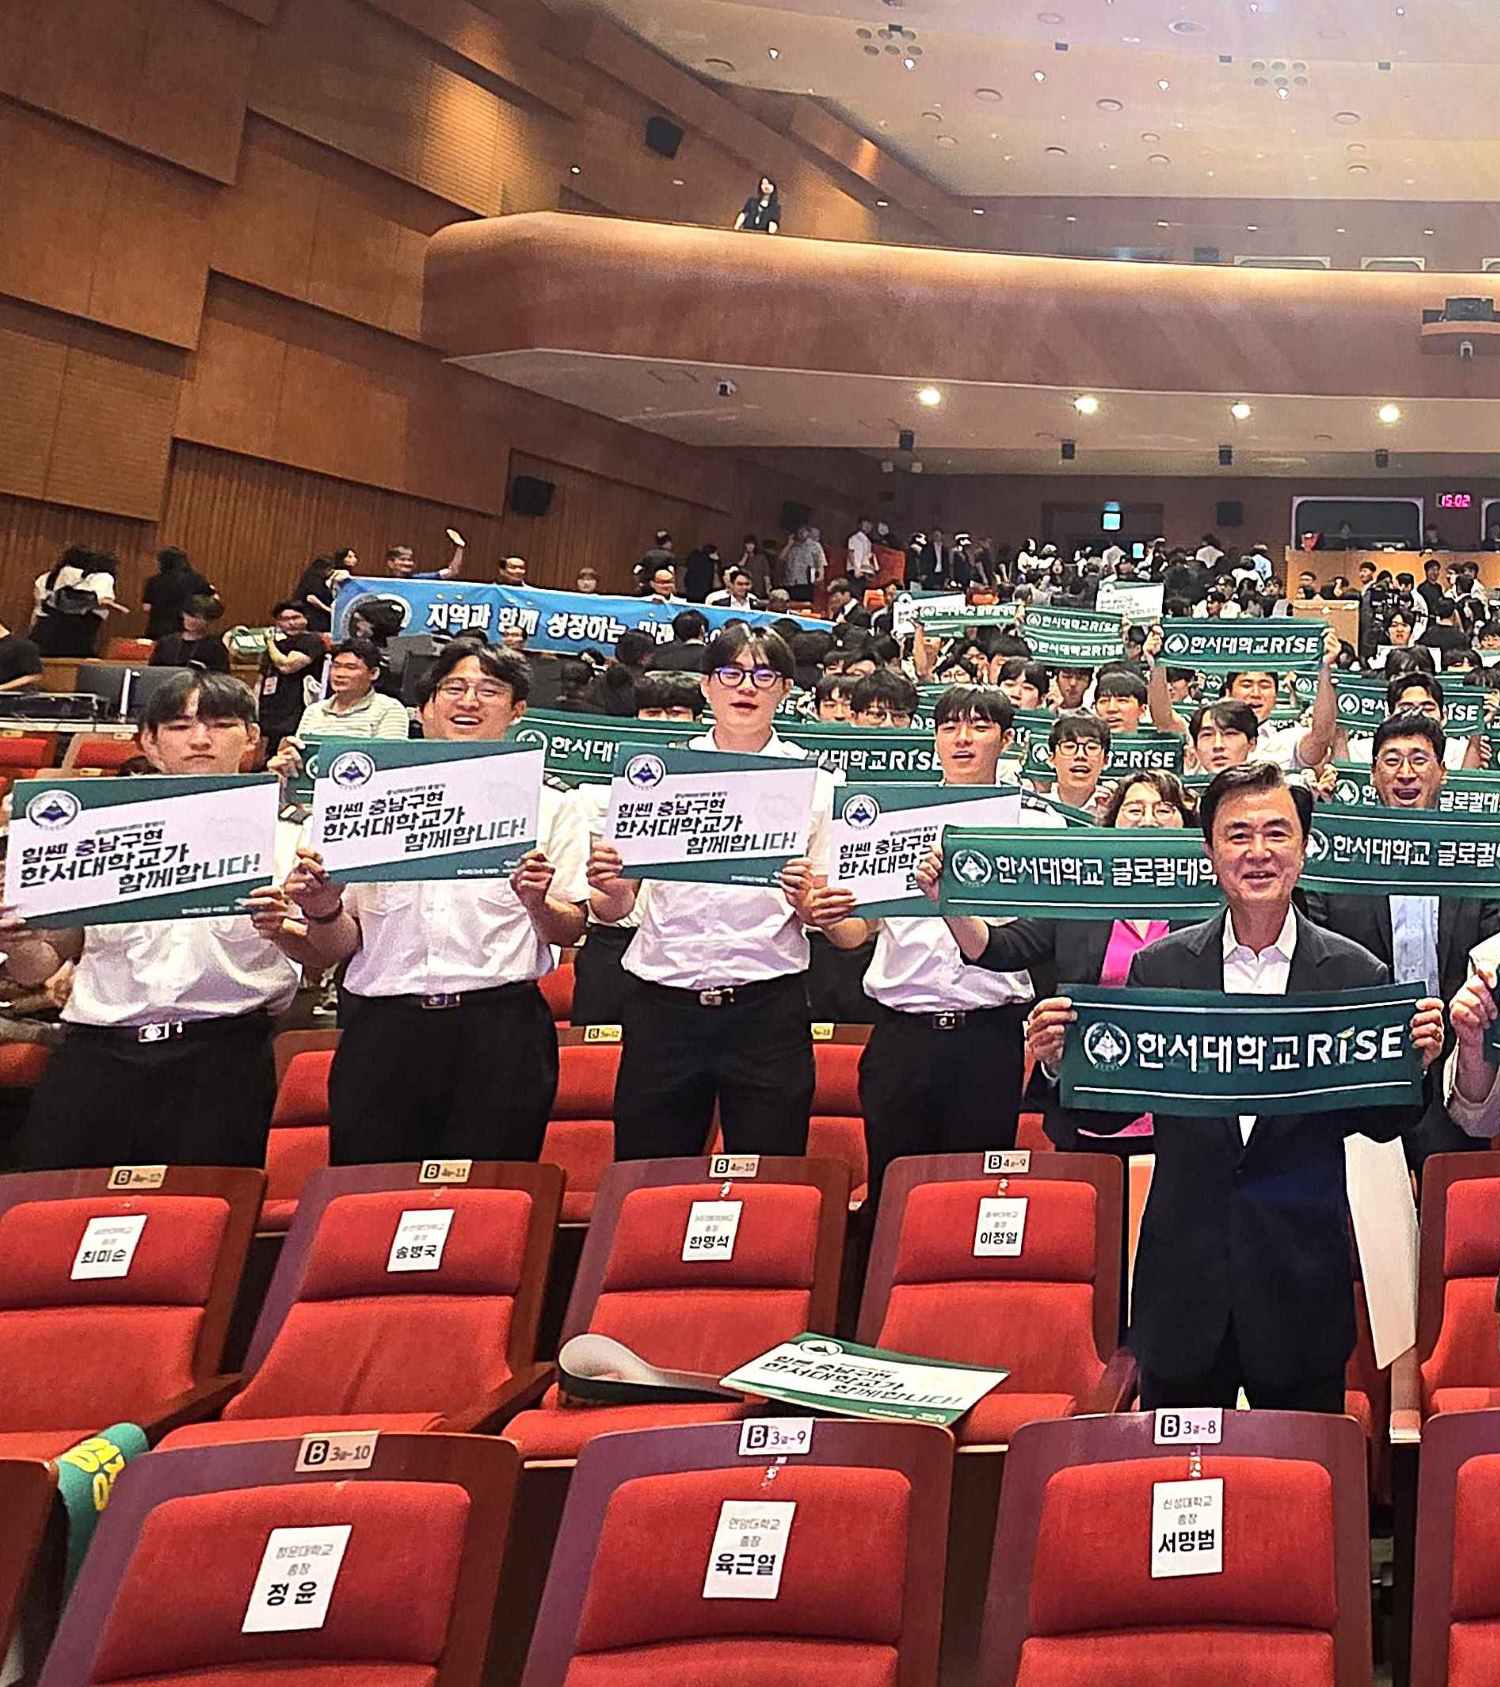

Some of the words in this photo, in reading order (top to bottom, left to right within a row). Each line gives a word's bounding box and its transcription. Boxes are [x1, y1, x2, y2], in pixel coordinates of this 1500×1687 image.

[1441, 494, 1471, 508] 15:02
[427, 603, 491, 631] 지역과
[547, 613, 627, 643] 성장하는
[1190, 635, 1318, 654] 한서대학교RISE
[368, 791, 444, 816] 충남구현
[657, 798, 726, 817] 충남구현
[322, 806, 465, 843] 한서대학교가
[404, 817, 526, 852] 함께합니다!
[614, 815, 743, 839] 한서대학교가
[75, 829, 163, 857] 충남구현
[686, 831, 797, 856] 함께합니다!
[840, 842, 871, 860] 힘쎈
[1333, 835, 1430, 866] 한서대학교
[20, 843, 189, 888] 한서대학교가
[119, 854, 261, 894] 함께합니다!
[839, 851, 931, 881] 한서대학
[995, 855, 1103, 886] 한서대학교
[1111, 858, 1217, 887] 글로컬대학
[1136, 1024, 1405, 1073] 한서대학교RISE
[750, 1426, 768, 1448] B
[1163, 1416, 1178, 1437] B
[308, 1442, 327, 1464] B
[1158, 1528, 1214, 1554] 서명범
[267, 1582, 289, 1607] 정
[294, 1580, 317, 1605] 윤
